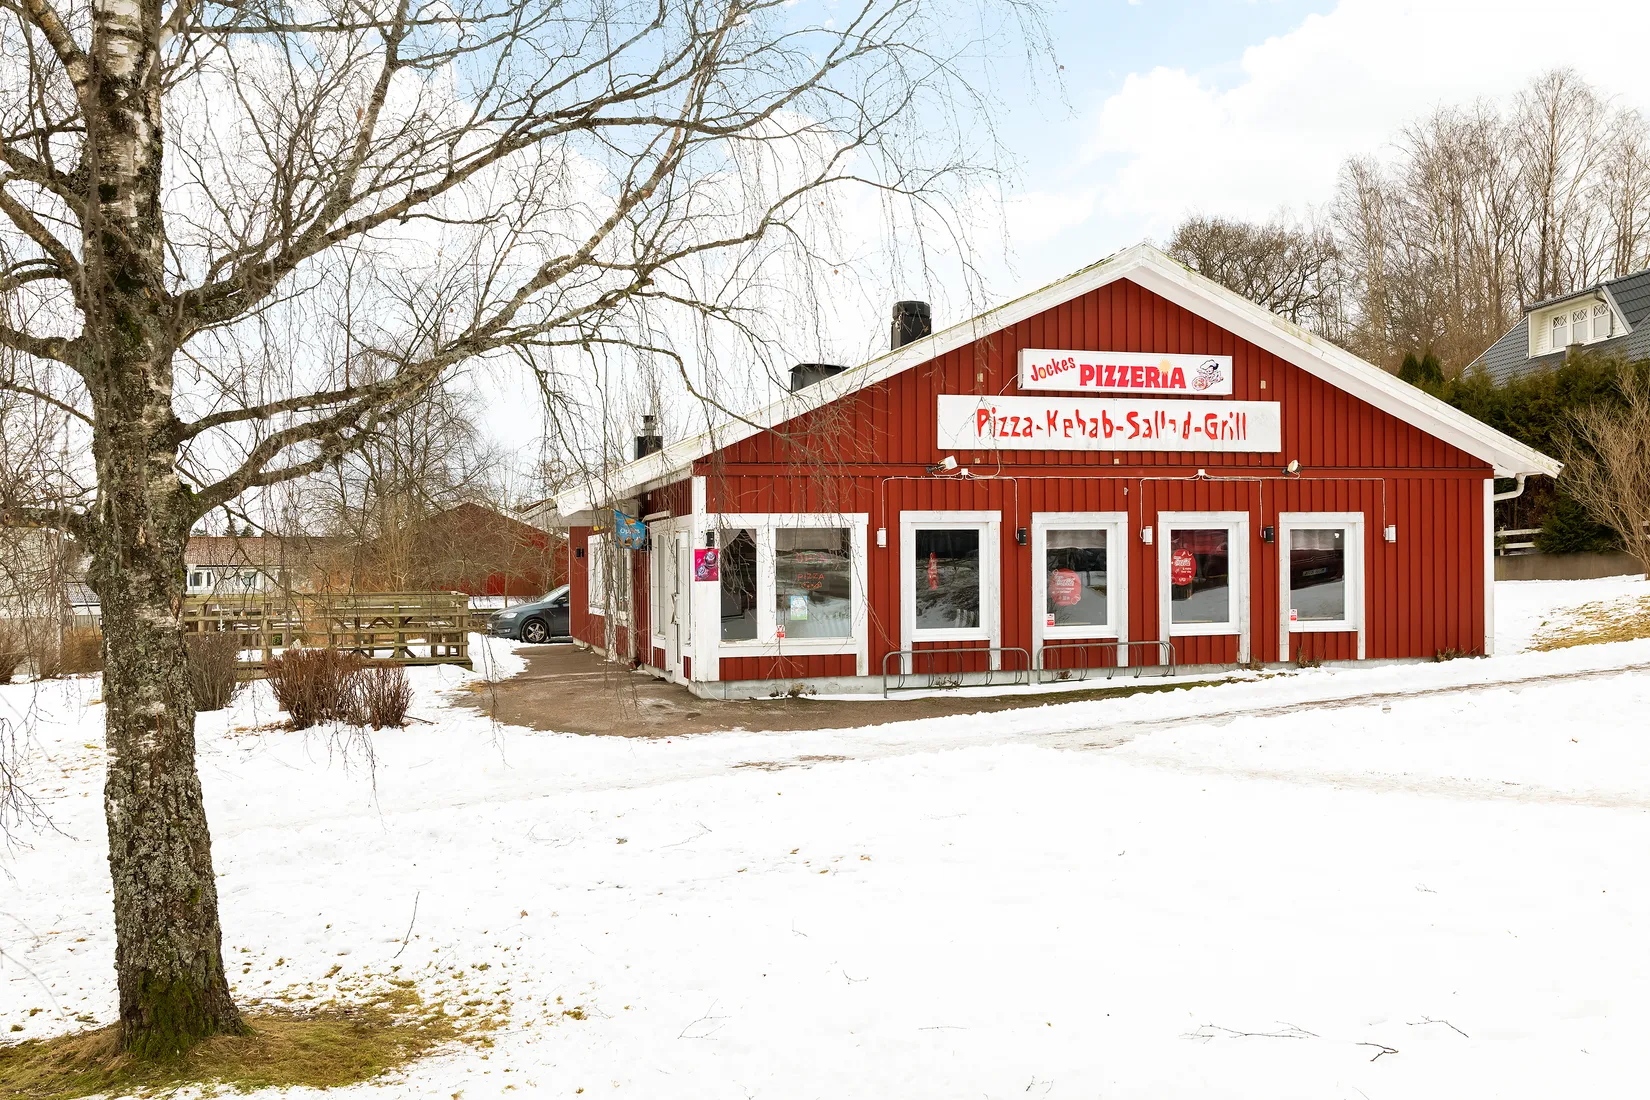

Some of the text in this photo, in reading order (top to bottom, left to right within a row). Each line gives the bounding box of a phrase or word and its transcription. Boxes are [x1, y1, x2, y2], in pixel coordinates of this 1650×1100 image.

[1031, 357, 1187, 389] Jockes PIZZERIA
[797, 572, 825, 581] PIZZA
